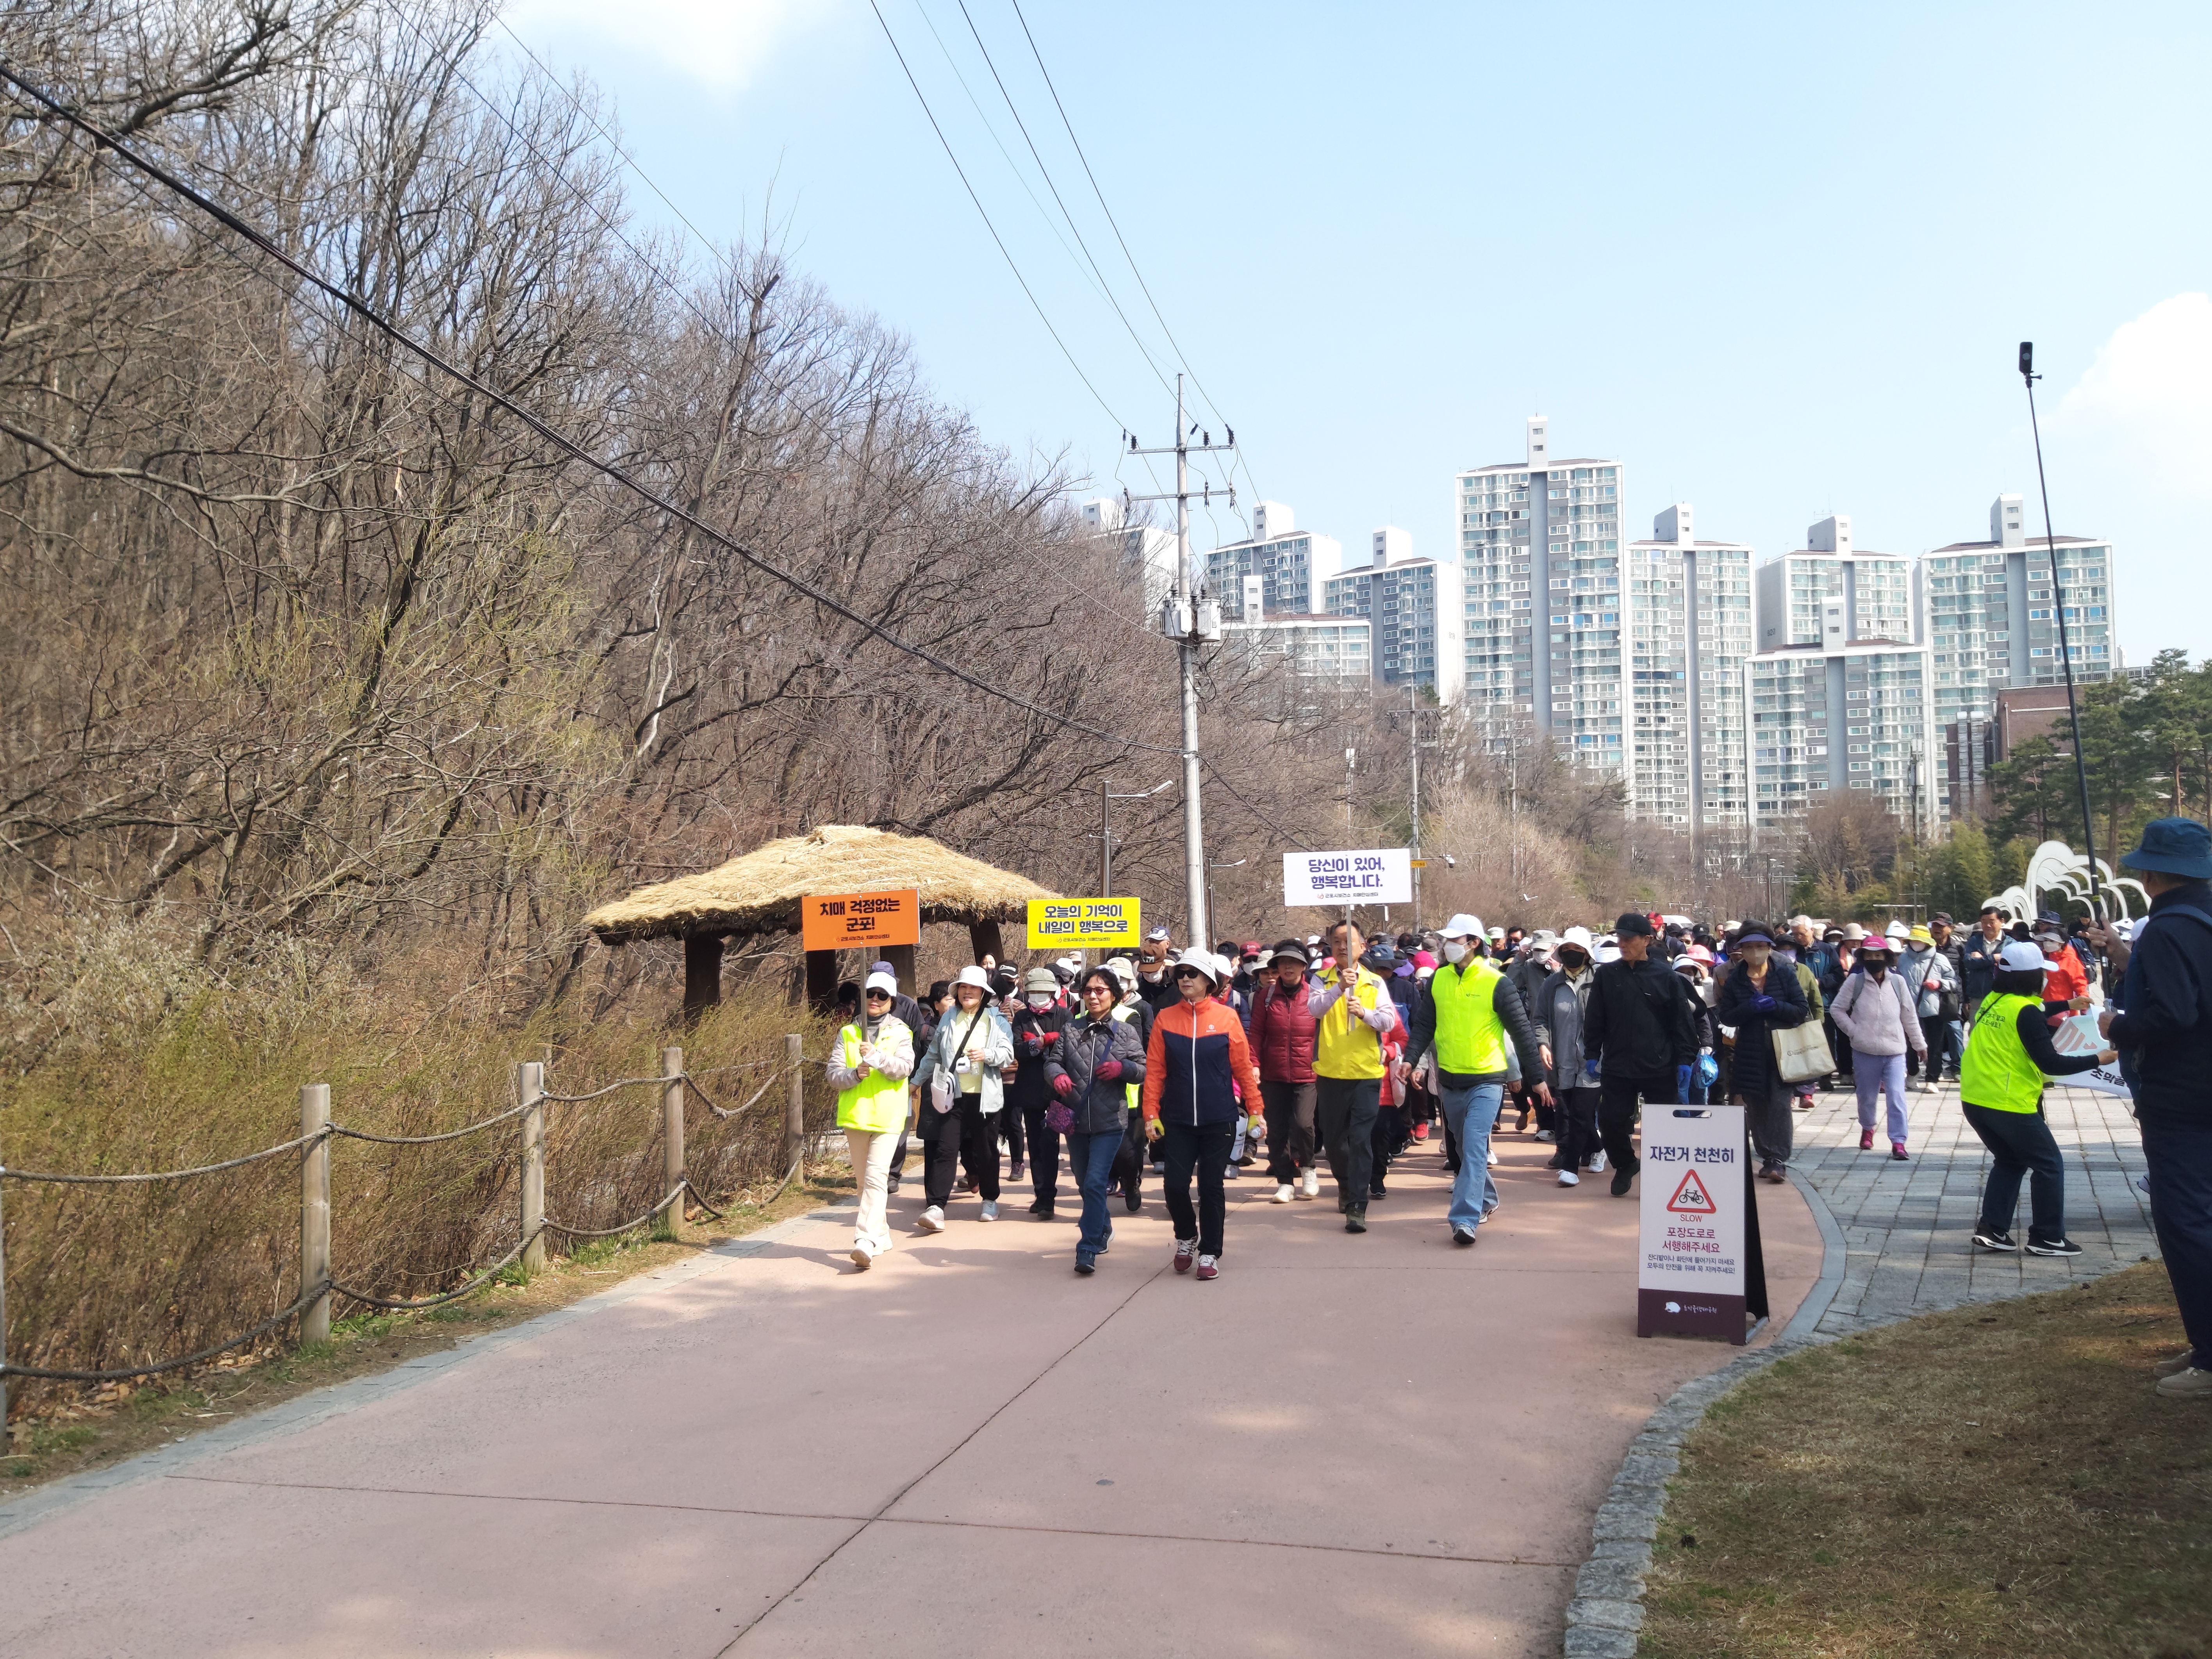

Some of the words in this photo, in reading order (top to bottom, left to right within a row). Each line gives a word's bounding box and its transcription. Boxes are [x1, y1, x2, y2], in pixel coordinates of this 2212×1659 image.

[1308, 858, 1349, 872] 당신이
[1354, 857, 1385, 872] 있어,
[1311, 874, 1383, 889] 행복합니다.
[820, 901, 846, 916] 치매
[850, 898, 900, 914] 걱정없는
[1045, 905, 1081, 918] 오늘의
[1086, 904, 1122, 917] 기억이
[846, 917, 875, 932] 군포!
[1038, 921, 1074, 933] 내일의
[1079, 920, 1128, 933] 행복으로
[1650, 1146, 1689, 1161] 자전거
[1694, 1147, 1734, 1163] 천천히
[1666, 1227, 1715, 1239] 포장도로로
[1662, 1240, 1720, 1253] 서행해주세요
[1677, 1255, 1693, 1263] 화단에
[1705, 1266, 1735, 1274] 지켜주세요!
